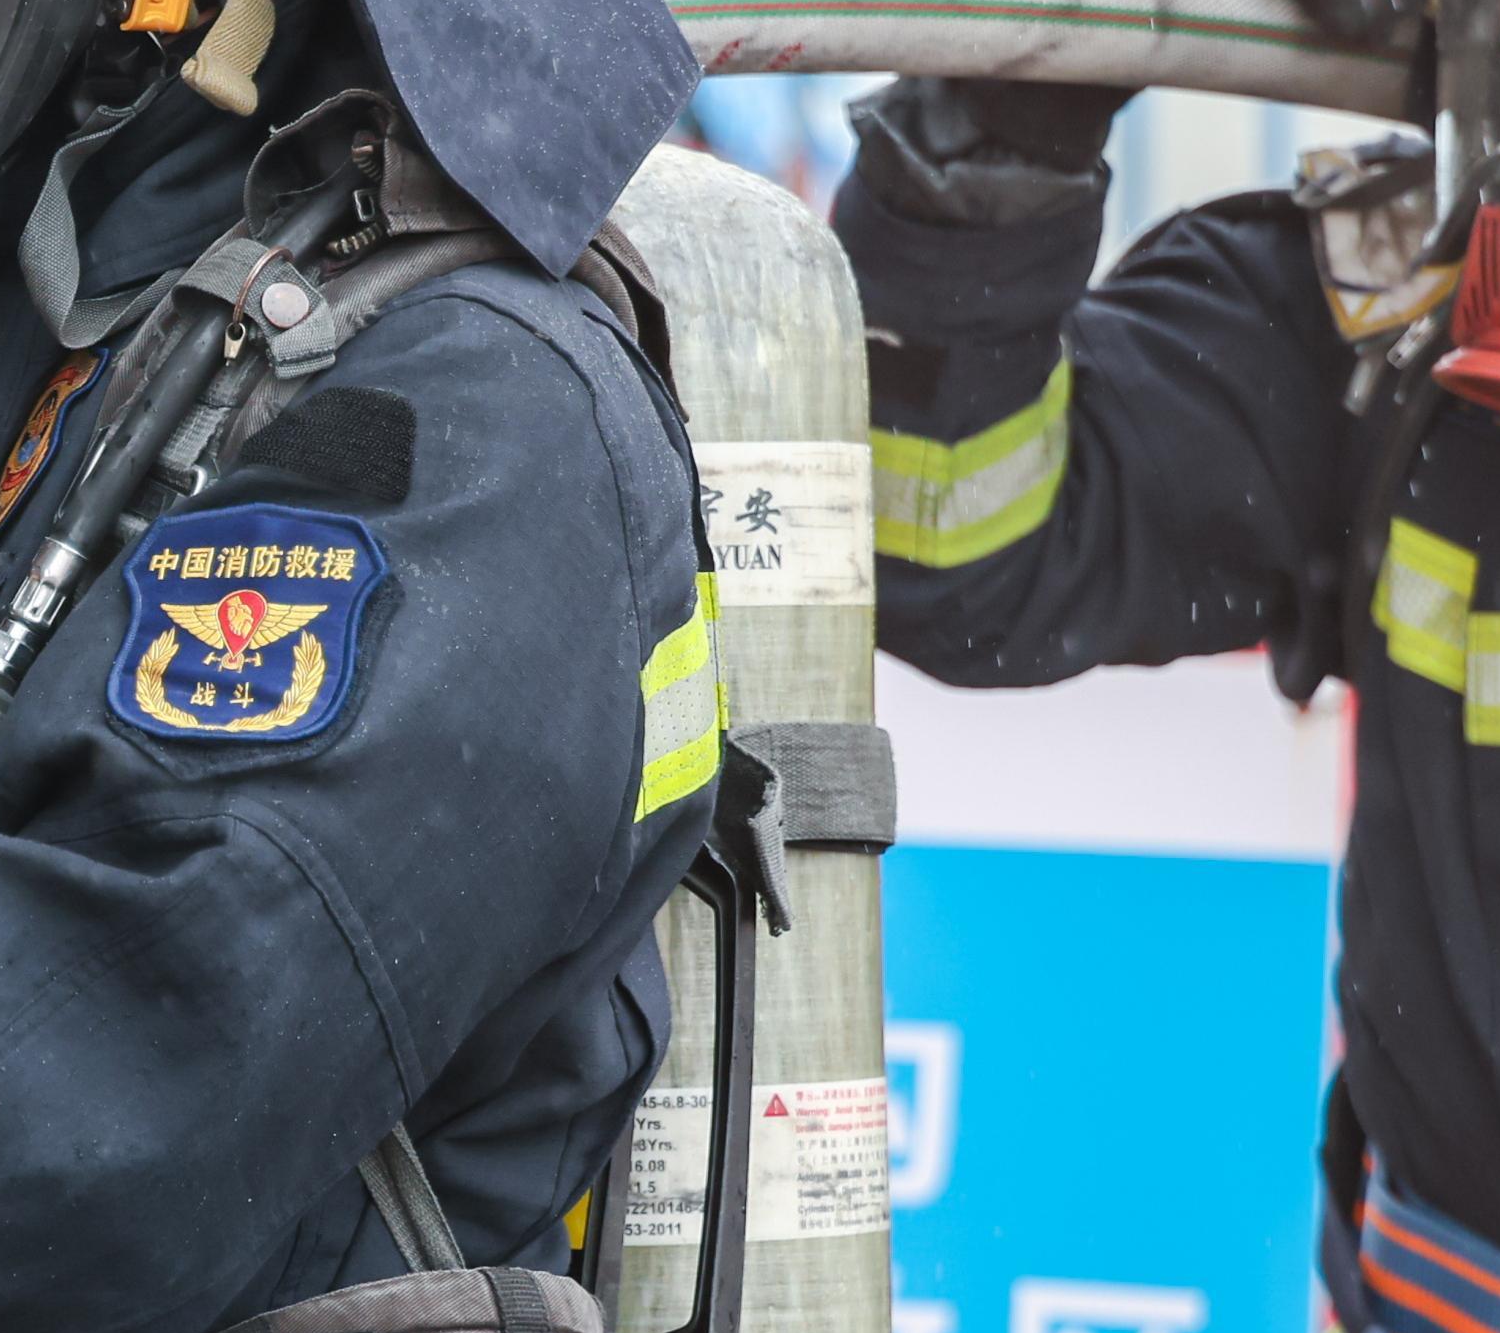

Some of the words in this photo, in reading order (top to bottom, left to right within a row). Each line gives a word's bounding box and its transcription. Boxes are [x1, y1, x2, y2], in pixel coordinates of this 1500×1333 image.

[147, 544, 358, 583] 中国消防救援
[188, 681, 256, 710] 战斗
